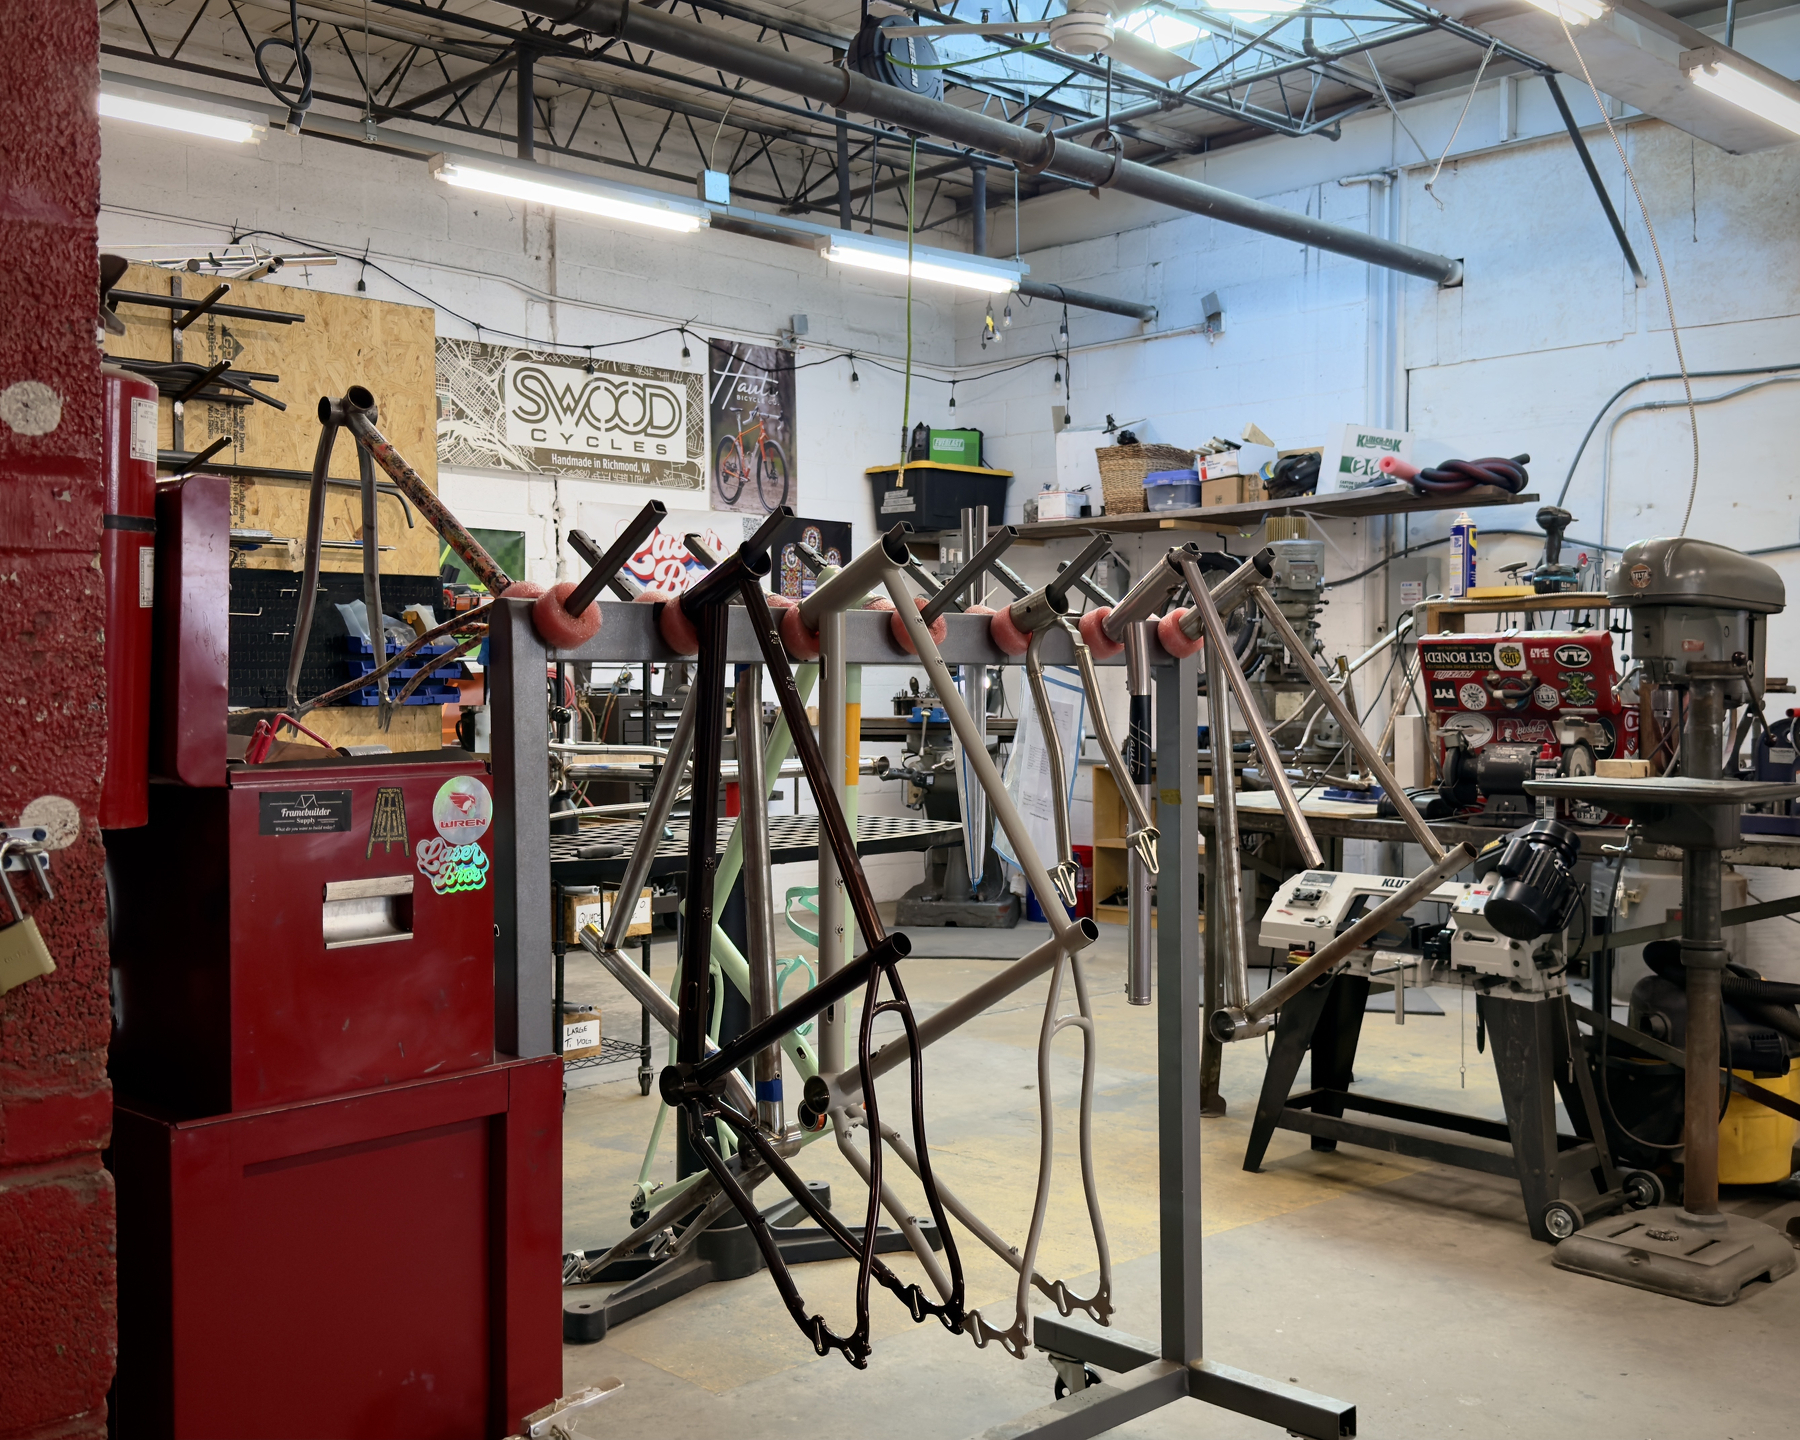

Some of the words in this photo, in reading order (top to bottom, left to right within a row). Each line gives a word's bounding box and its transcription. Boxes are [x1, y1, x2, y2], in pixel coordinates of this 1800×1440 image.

[512, 366, 682, 439] SWOOD
[736, 394, 765, 404] BICYCLE
[531, 428, 667, 455] CYCLES
[551, 453, 592, 467] Handmade
[593, 457, 601, 468] in
[602, 458, 640, 473] Richmond,
[641, 462, 650, 473] VA
[1424, 652, 1467, 663] BONED!
[1470, 652, 1492, 663] GET
[1557, 651, 1589, 662] ZLA
[281, 807, 331, 817] Framebuilder
[1577, 811, 1601, 820] BEER
[440, 818, 486, 829] WREN
[417, 837, 485, 871] Laser
[434, 861, 482, 886] Bros
[566, 1024, 588, 1037] LARGE
